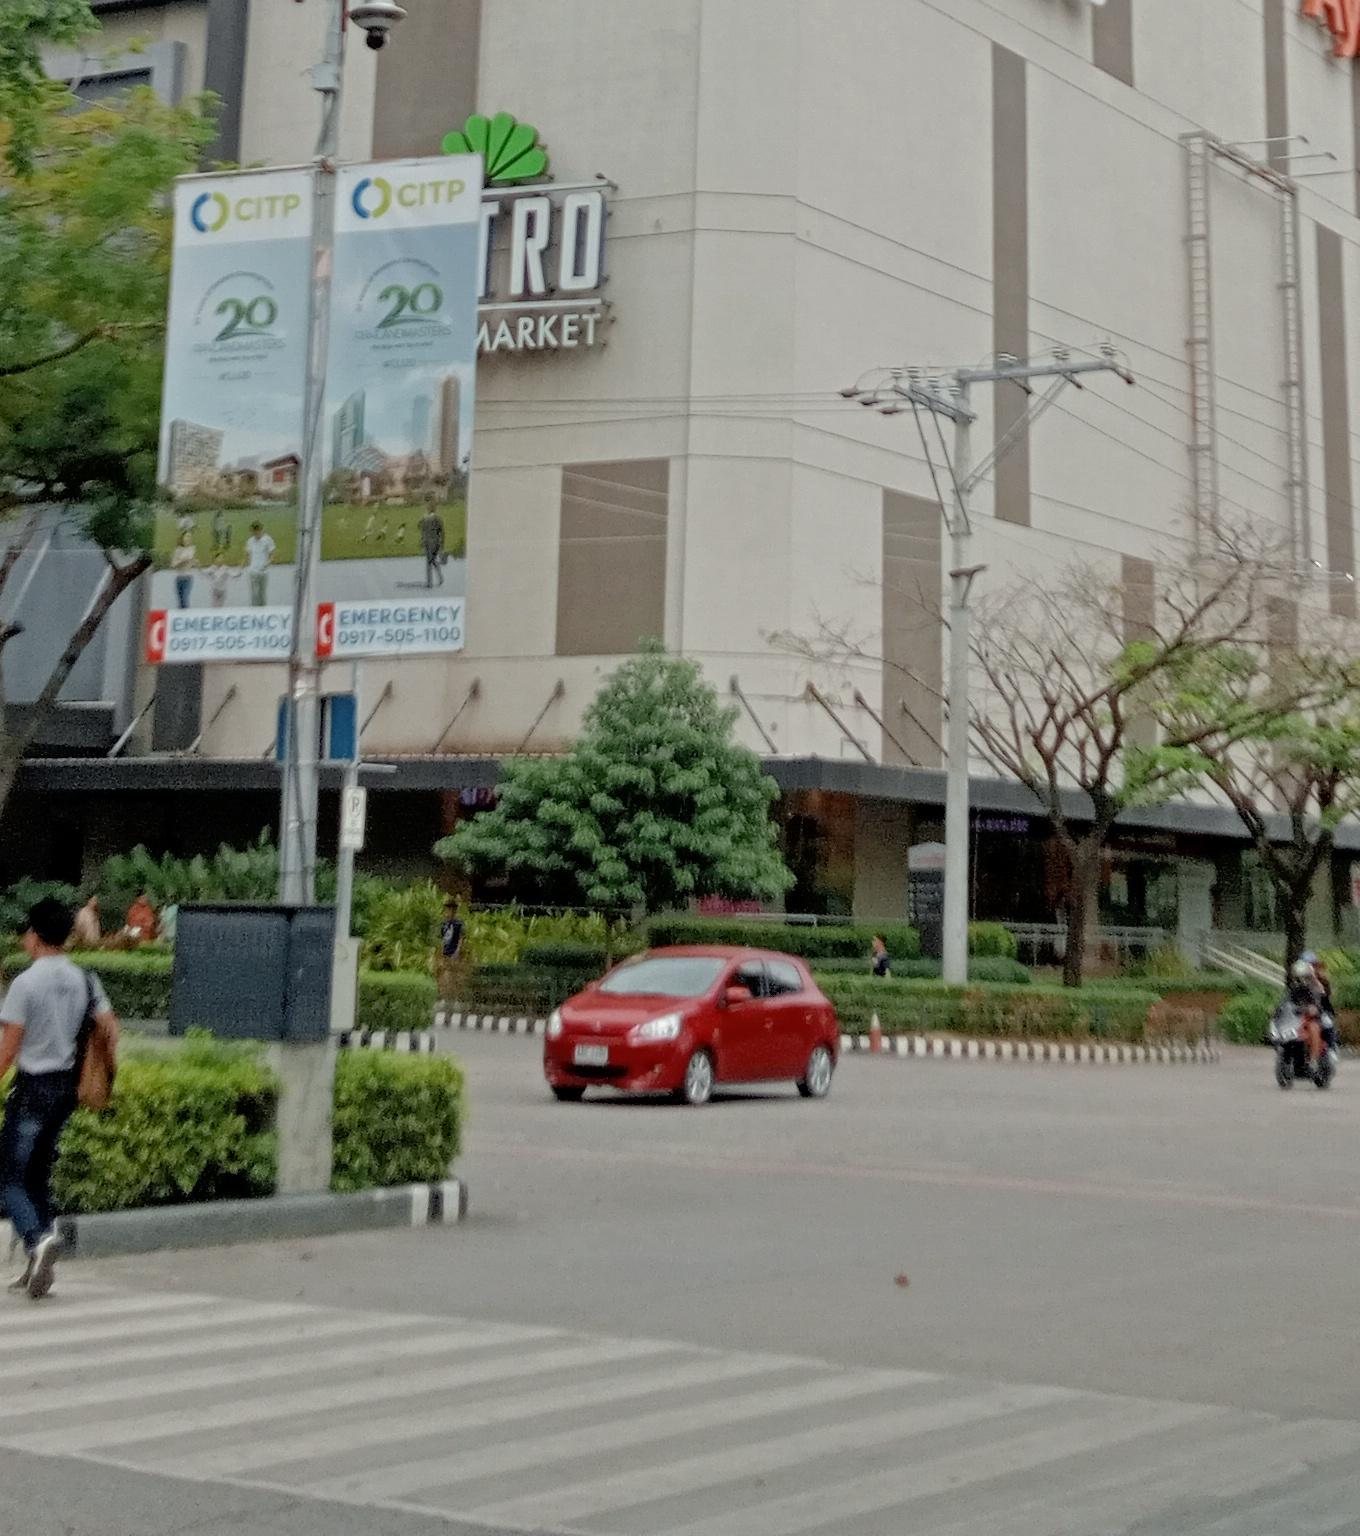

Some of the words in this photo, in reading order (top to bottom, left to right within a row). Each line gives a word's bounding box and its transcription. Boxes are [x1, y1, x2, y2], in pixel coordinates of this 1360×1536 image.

[235, 192, 301, 222] CITP
[397, 178, 466, 208] CITP
[477, 191, 603, 299] TRO
[215, 295, 279, 342] 20
[376, 282, 444, 330] 20
[476, 313, 602, 352] MARKET
[171, 613, 290, 633] EMERGENCY
[339, 605, 462, 626] EMERGENCY
[169, 634, 290, 652] 0917-505-1100
[337, 626, 461, 646] 0917-505-1100
